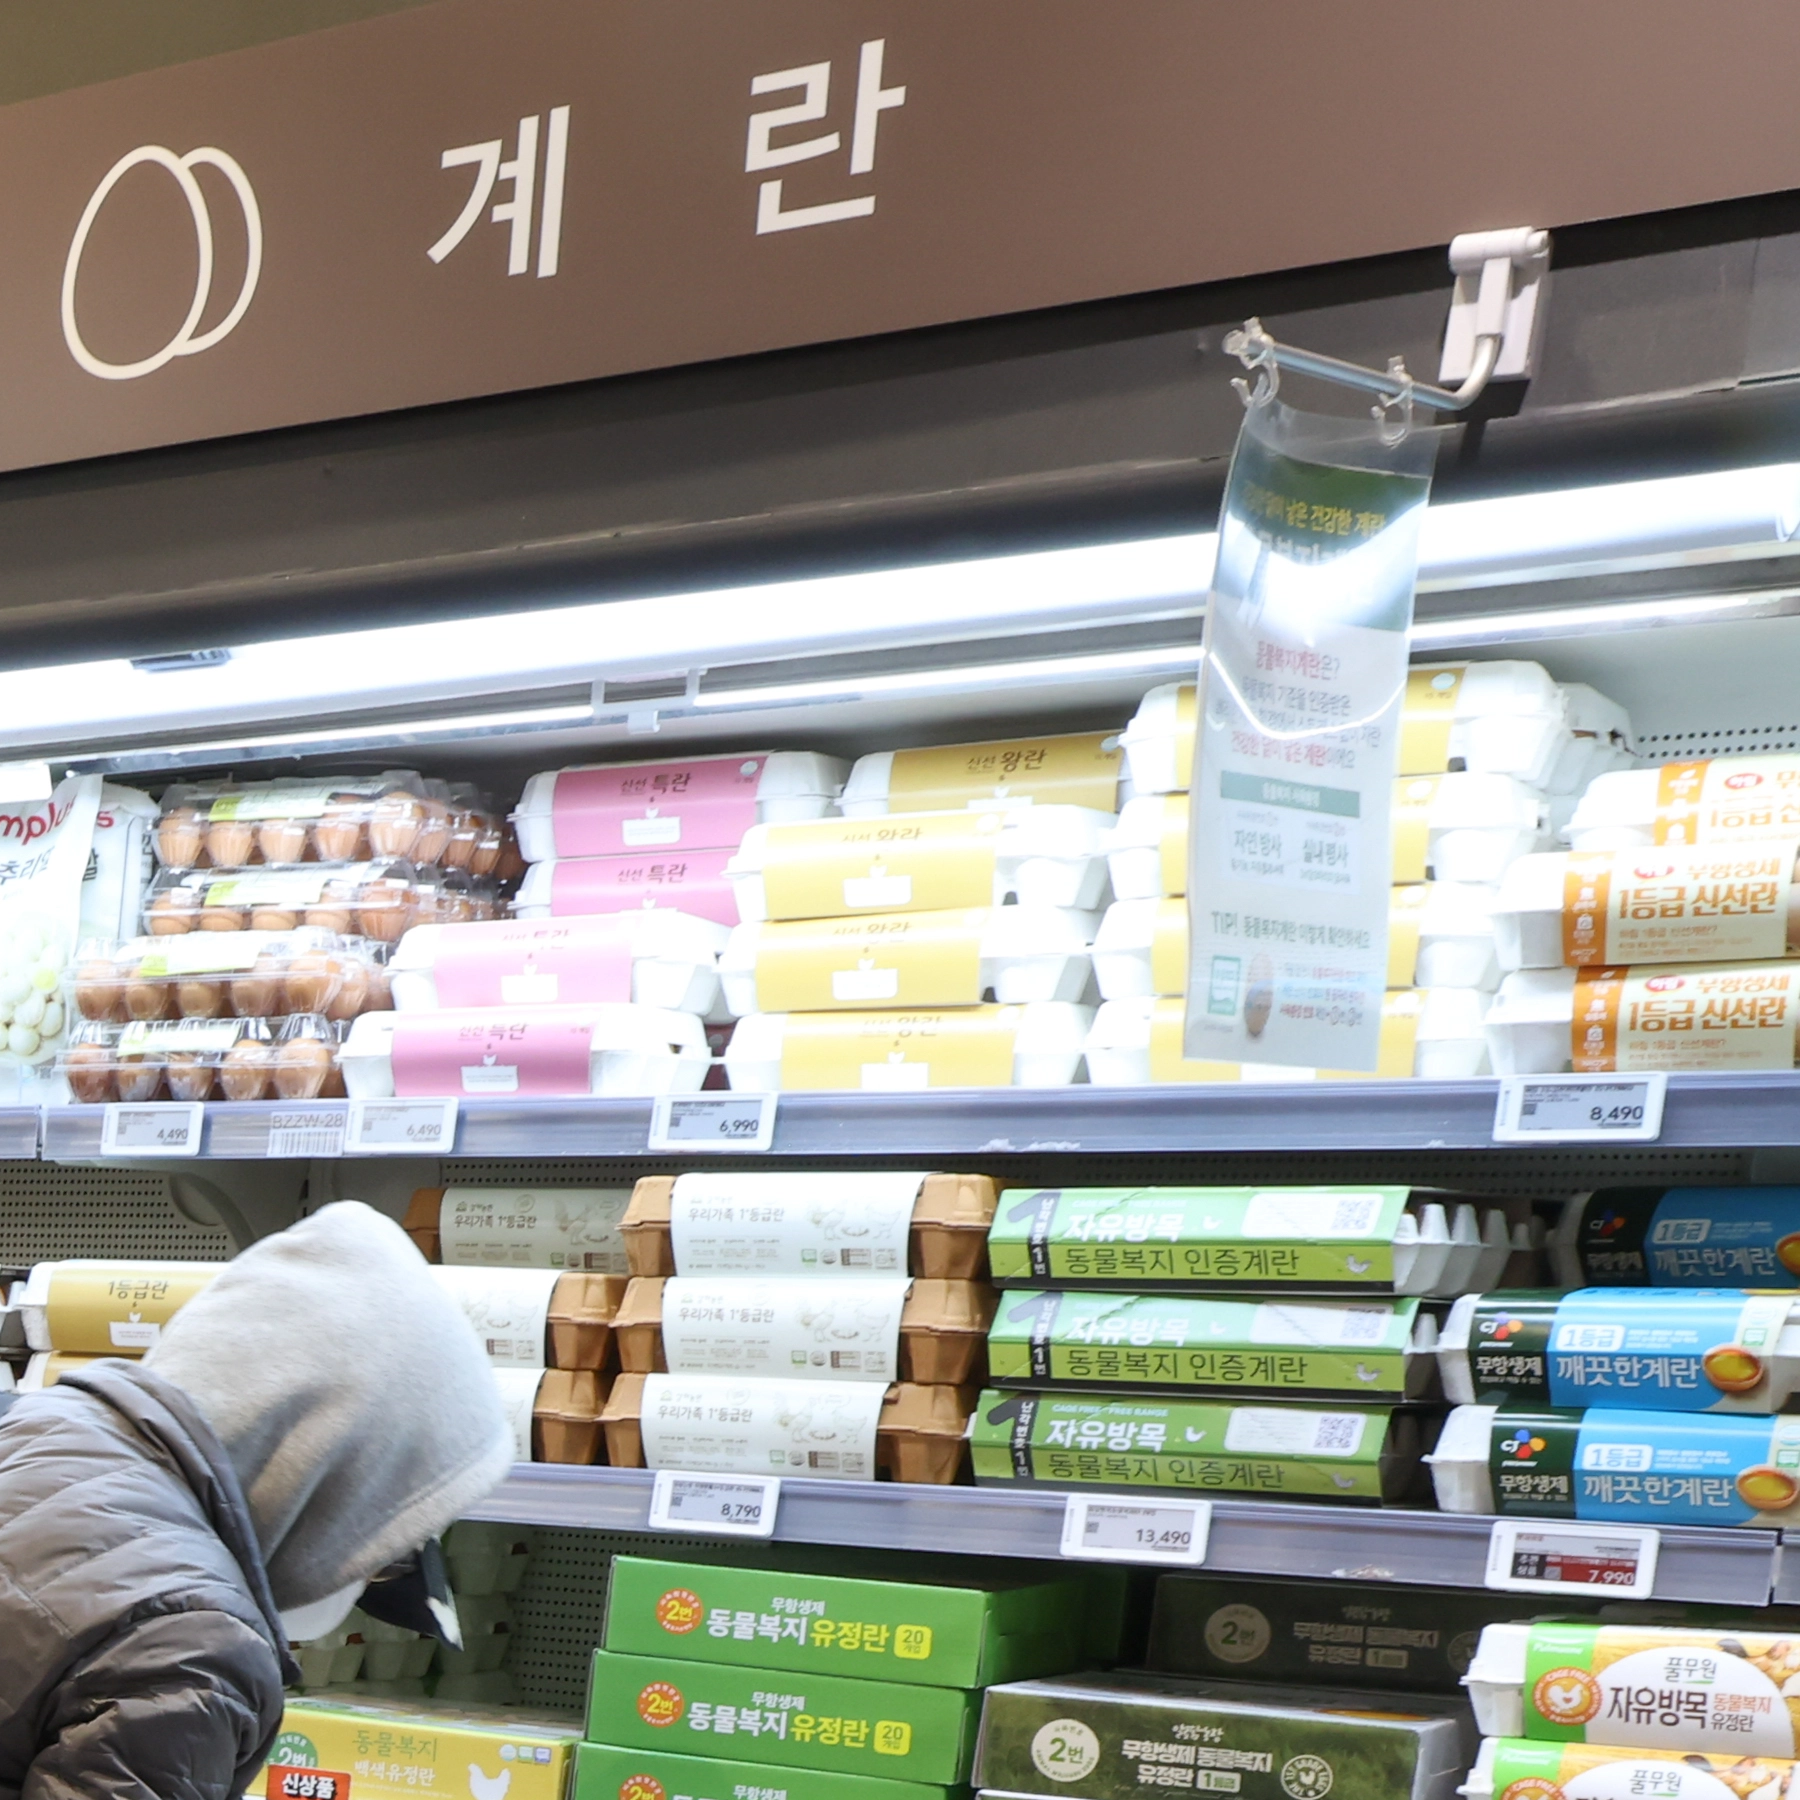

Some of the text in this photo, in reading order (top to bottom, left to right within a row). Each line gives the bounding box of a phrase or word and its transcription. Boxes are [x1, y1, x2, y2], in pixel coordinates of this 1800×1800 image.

[272, 1114, 344, 1130] BZZW-28
[720, 1119, 758, 1133] 6,990
[1590, 1106, 1643, 1123] 8,490
[157, 1128, 189, 1142] 4,490
[407, 1123, 441, 1138] 6,490
[1063, 1213, 1186, 1242] 자유방목
[1064, 1248, 1299, 1276] 동물복지 인증계란
[108, 1279, 169, 1300] 1등급란
[1066, 1350, 1308, 1384] 동물복지 인증계란
[1557, 1355, 1699, 1388] 깨끗한계란
[1045, 1419, 1167, 1452] 자유방목
[1048, 1453, 1284, 1489] 동물복지 인증계란
[1584, 1475, 1732, 1508] 깨끗한계란
[721, 1503, 760, 1518] 8,790
[1135, 1528, 1191, 1547] 13,490
[1588, 1569, 1636, 1586] 7,990
[667, 1599, 693, 1622] 2번
[771, 1596, 825, 1616] 무항생제
[707, 1607, 924, 1653] 동물복지 유정란 20
[1665, 1656, 1717, 1684] 풀무원
[751, 1691, 806, 1711] 무항생제
[1607, 1685, 1771, 1730] 자유방목 동물복지
[688, 1702, 904, 1748] 동물복지 유정란 20
[1710, 1712, 1754, 1733] 유정란
[352, 1730, 438, 1762] 동물복지
[1048, 1735, 1086, 1765] 2번
[1121, 1738, 1273, 1774] 무항생제 동물복지
[282, 1773, 338, 1800] 신상품
[355, 1759, 436, 1787] 백색유정란
[1137, 1763, 1193, 1788] 유정란
[1630, 1768, 1683, 1796] 풀무원
